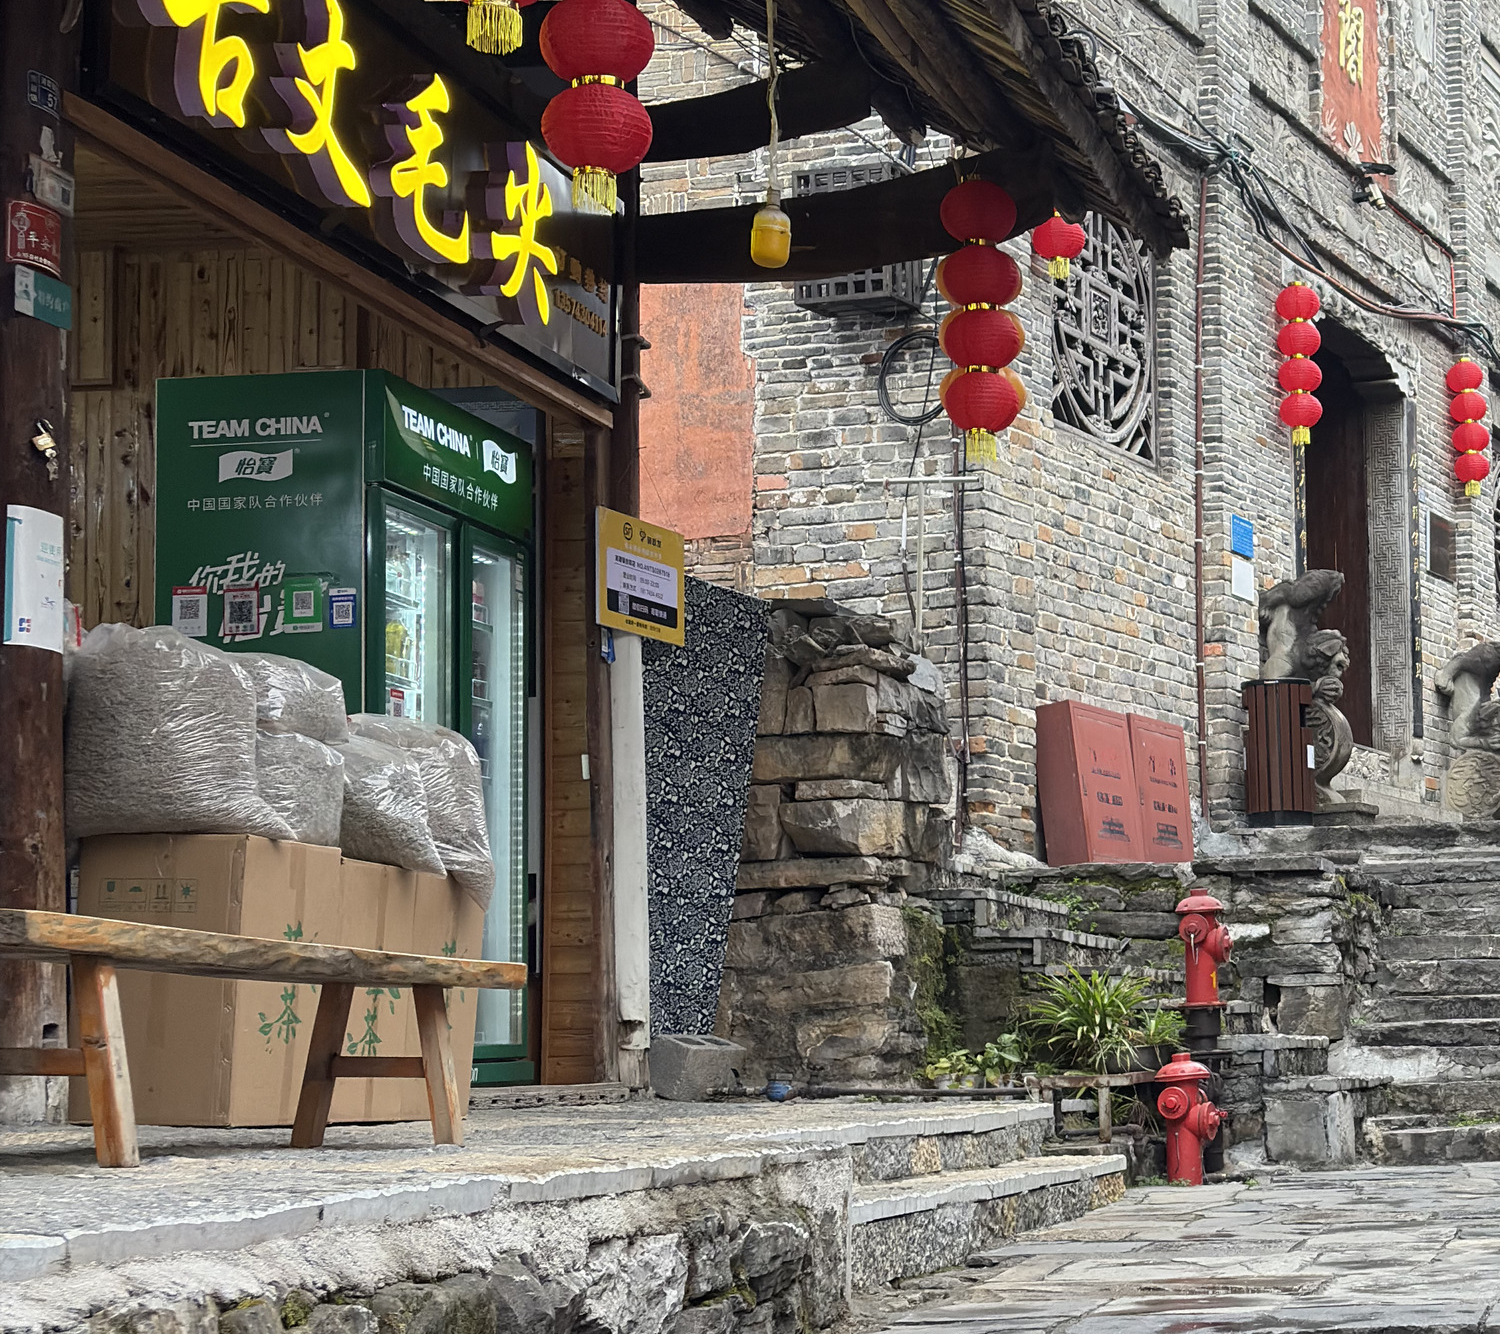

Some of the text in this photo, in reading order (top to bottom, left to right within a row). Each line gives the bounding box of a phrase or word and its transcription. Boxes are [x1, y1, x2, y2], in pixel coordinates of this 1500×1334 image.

[188, 415, 323, 439] TEAM CHINA
[401, 404, 471, 458] TEAM CHINA
[234, 456, 277, 476] 怡寶
[491, 450, 509, 476] 怡寶
[422, 463, 499, 511] 中国国家队合作伙伴
[187, 492, 324, 512] 中国国家队合作伙伴
